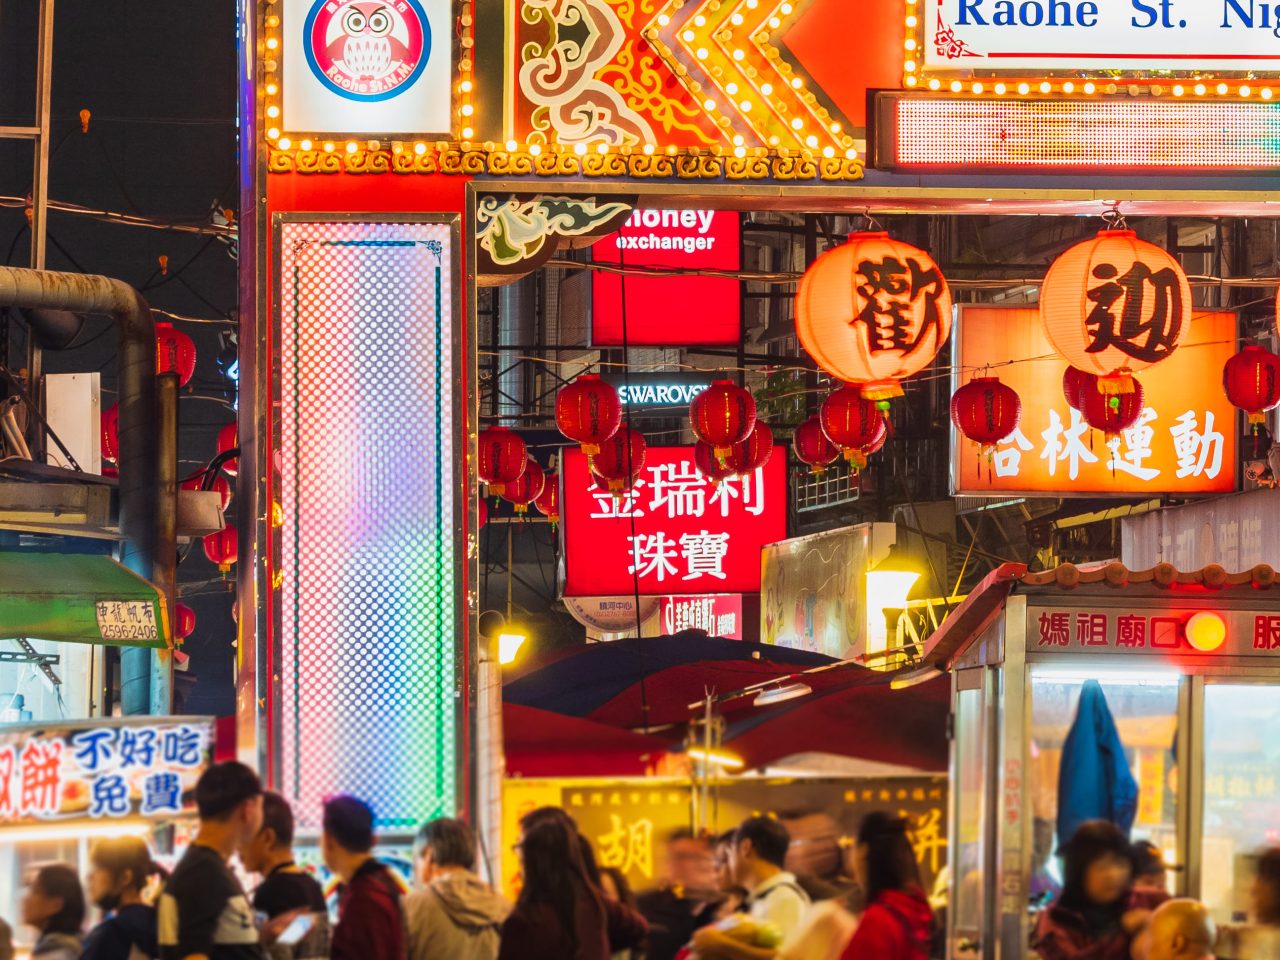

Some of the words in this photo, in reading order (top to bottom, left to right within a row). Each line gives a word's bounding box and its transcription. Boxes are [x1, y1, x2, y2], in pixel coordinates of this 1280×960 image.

[616, 234, 715, 253] exchanger
[1086, 262, 1184, 363] 迎
[618, 384, 712, 404] SWAROVS
[587, 460, 764, 519] 金瑞利
[627, 530, 730, 581] 珠寶
[102, 624, 158, 639] 2596-2406
[1038, 611, 1182, 650] 媽祖廟口
[75, 729, 200, 769] 不好吃
